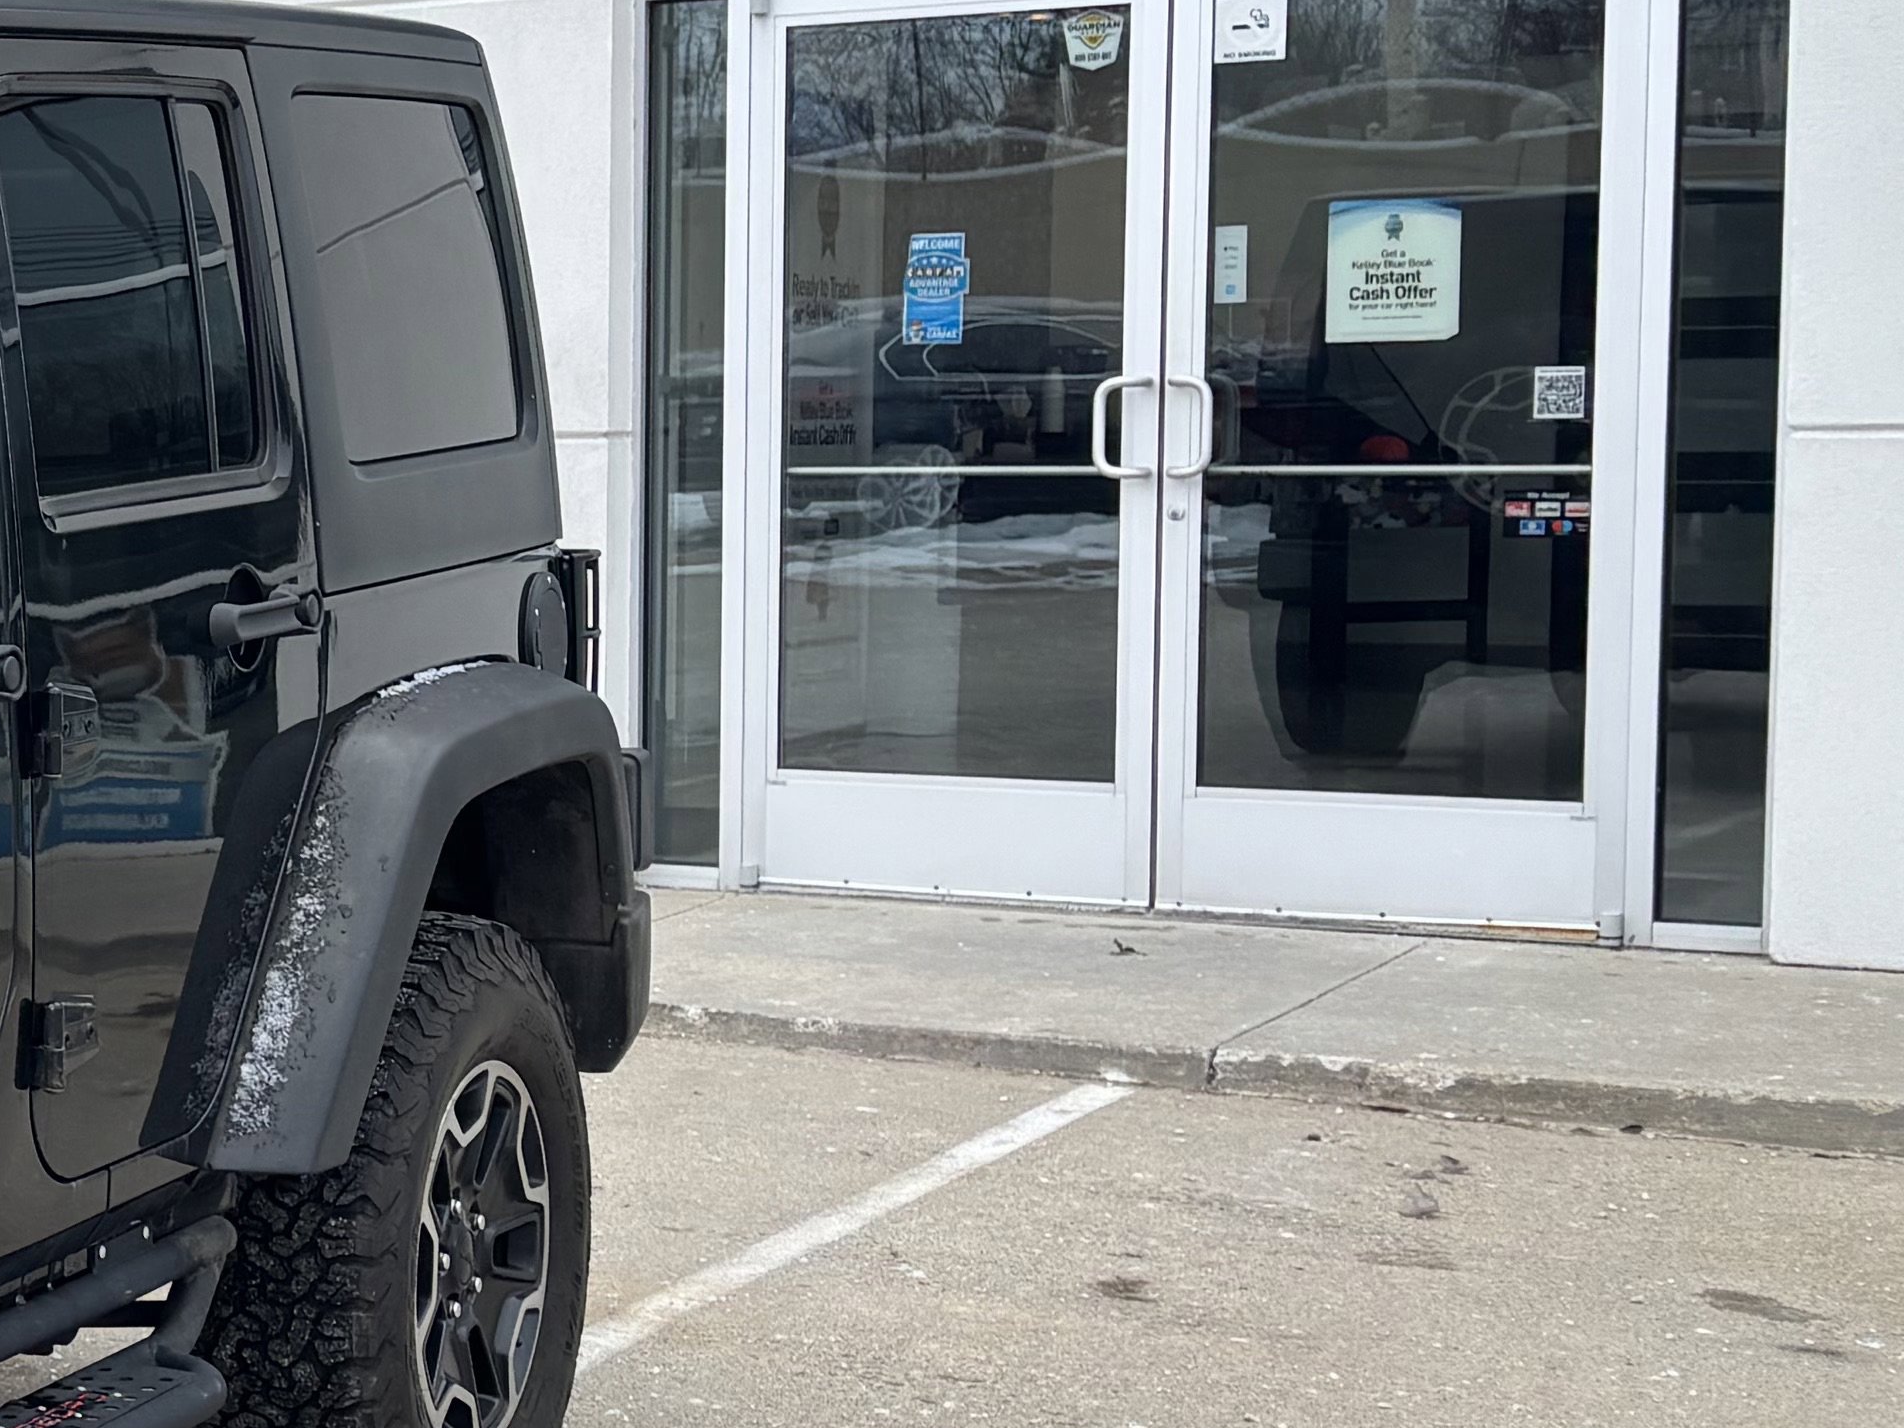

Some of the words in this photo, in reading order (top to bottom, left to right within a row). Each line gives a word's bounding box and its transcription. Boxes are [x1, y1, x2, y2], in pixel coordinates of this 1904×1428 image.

[912, 239, 960, 250] WELCOME
[1381, 249, 1397, 258] Get
[1352, 261, 1382, 271] Kelley
[1384, 259, 1406, 269] Blue
[1365, 269, 1421, 285] Instant
[917, 288, 950, 297] DEALER
[1350, 286, 1390, 301] Cash
[1395, 285, 1437, 300] Offer
